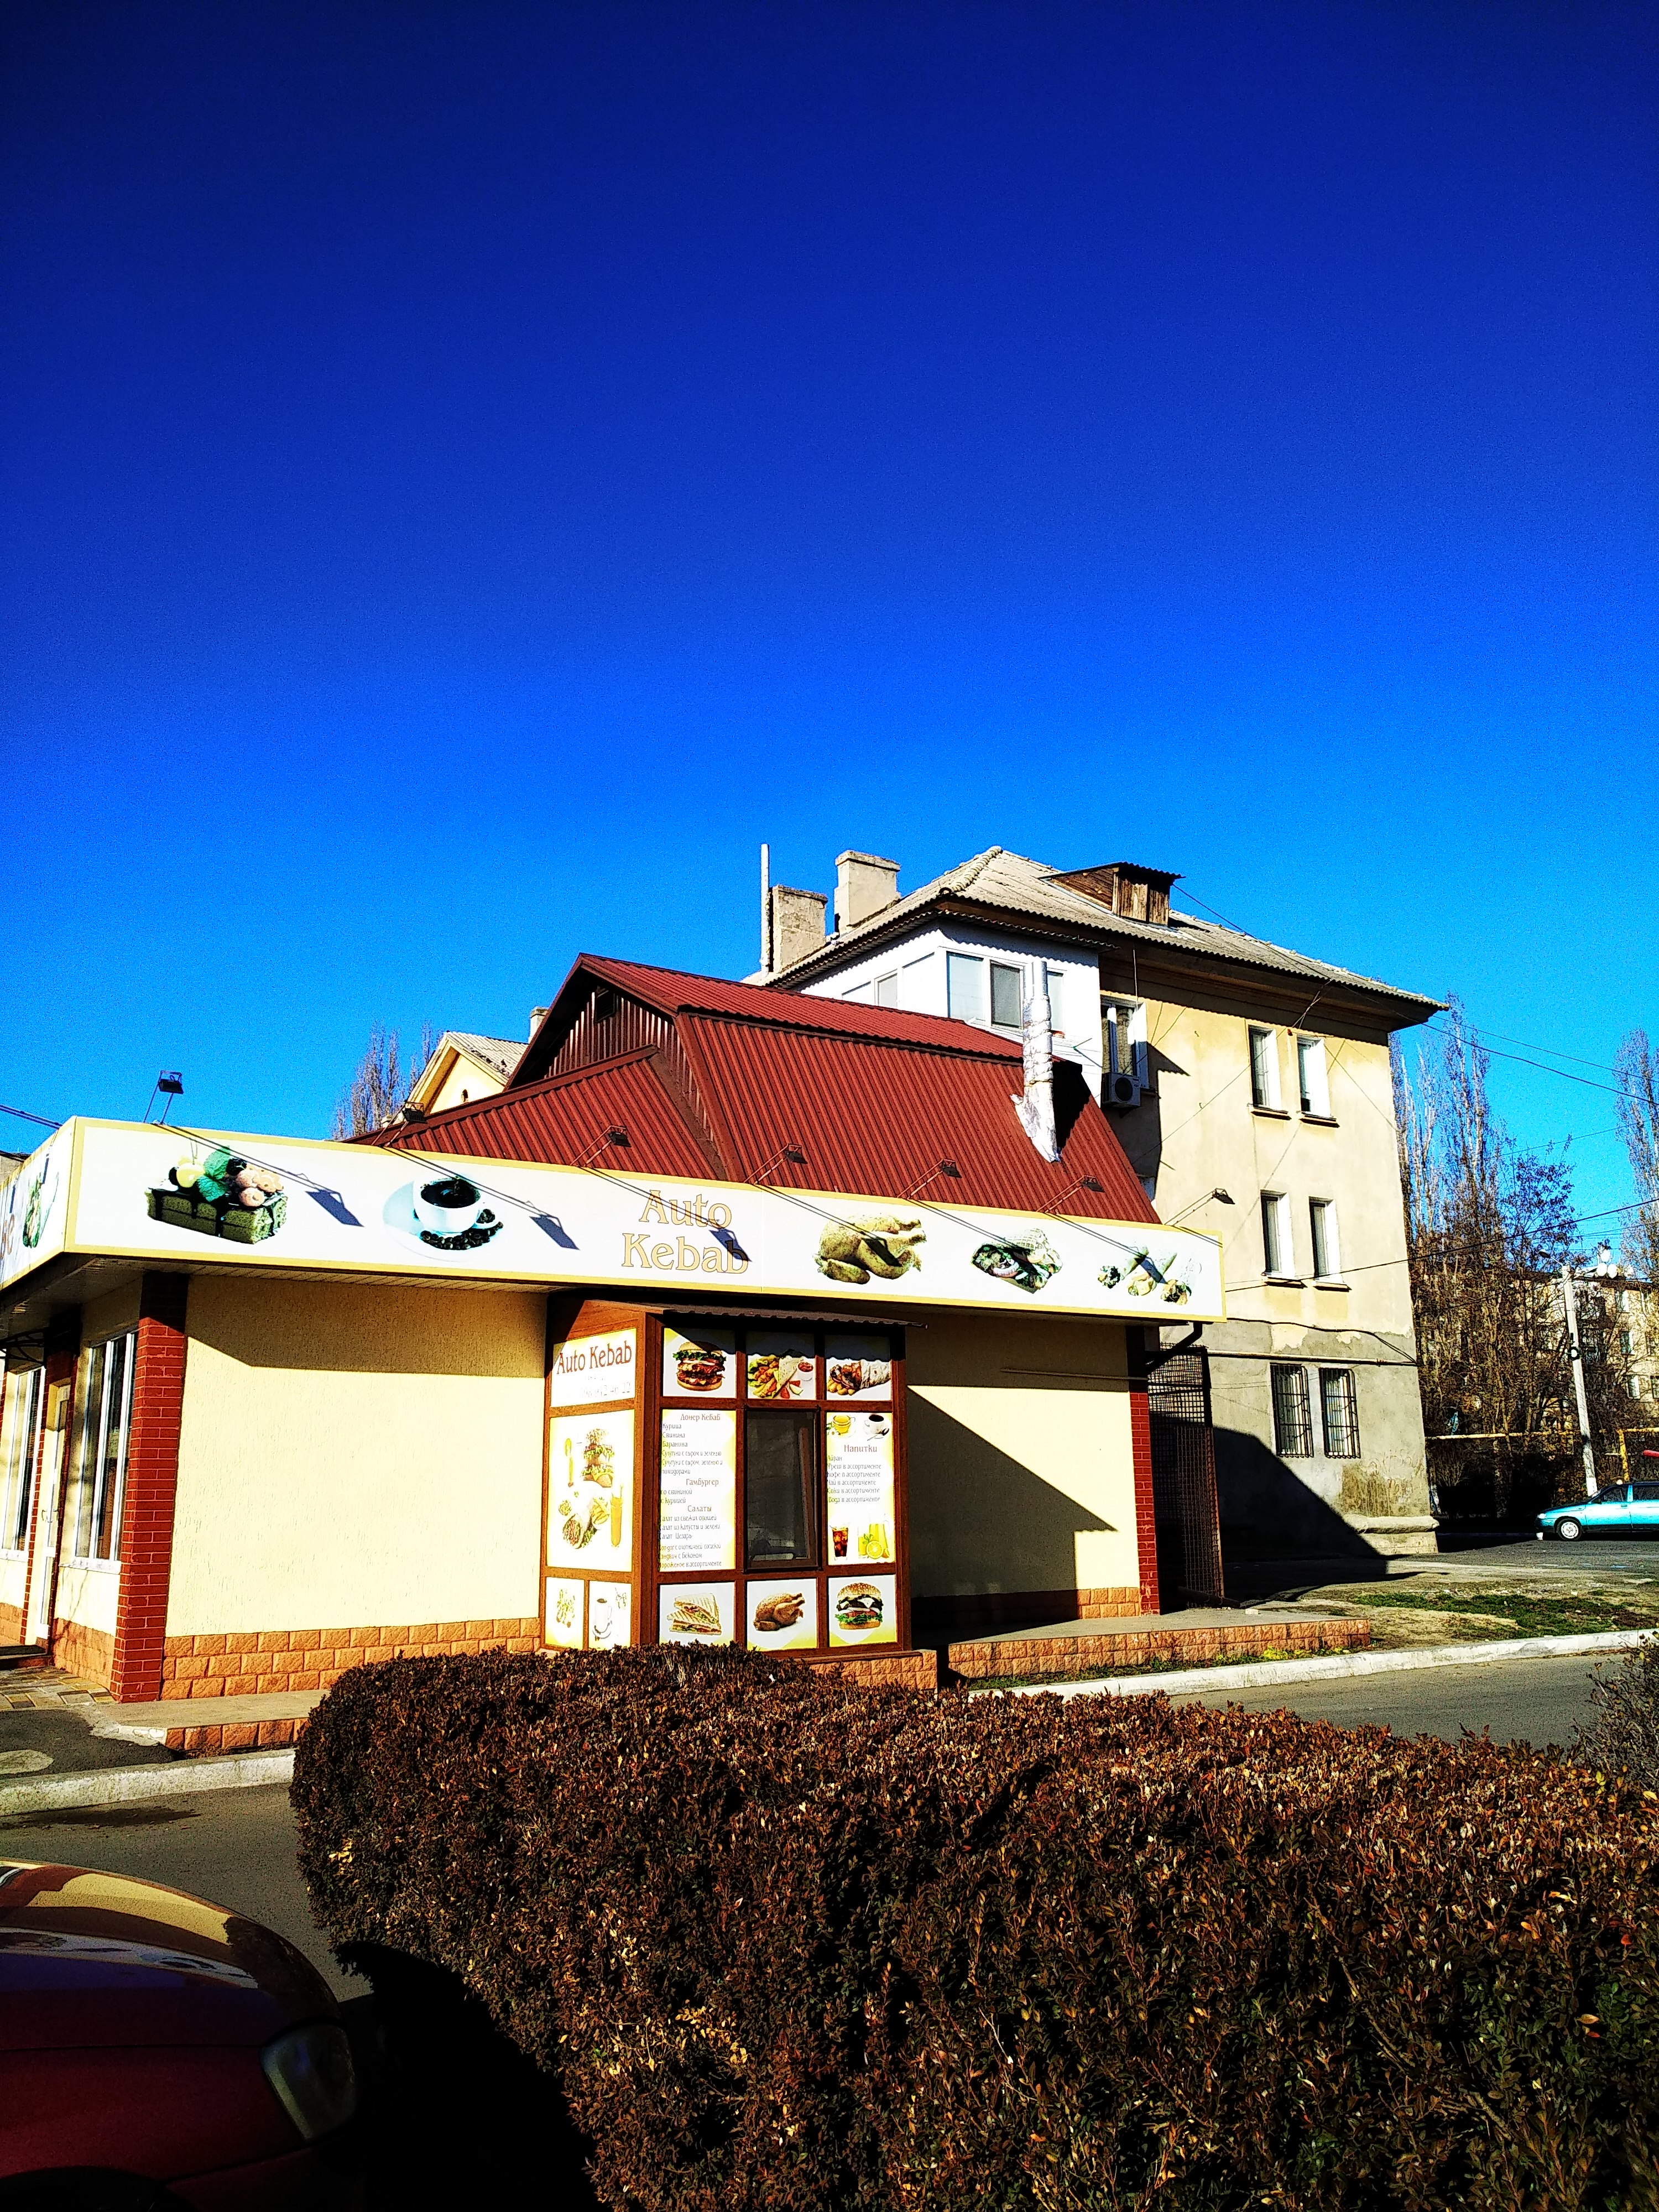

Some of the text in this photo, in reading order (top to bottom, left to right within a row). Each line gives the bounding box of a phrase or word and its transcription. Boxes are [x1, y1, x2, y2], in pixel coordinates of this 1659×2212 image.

[639, 1190, 732, 1229] Auto
[622, 1233, 748, 1274] Kebab
[556, 1340, 632, 1375] Auto Kebab
[686, 1478, 719, 1486] Гамбургер
